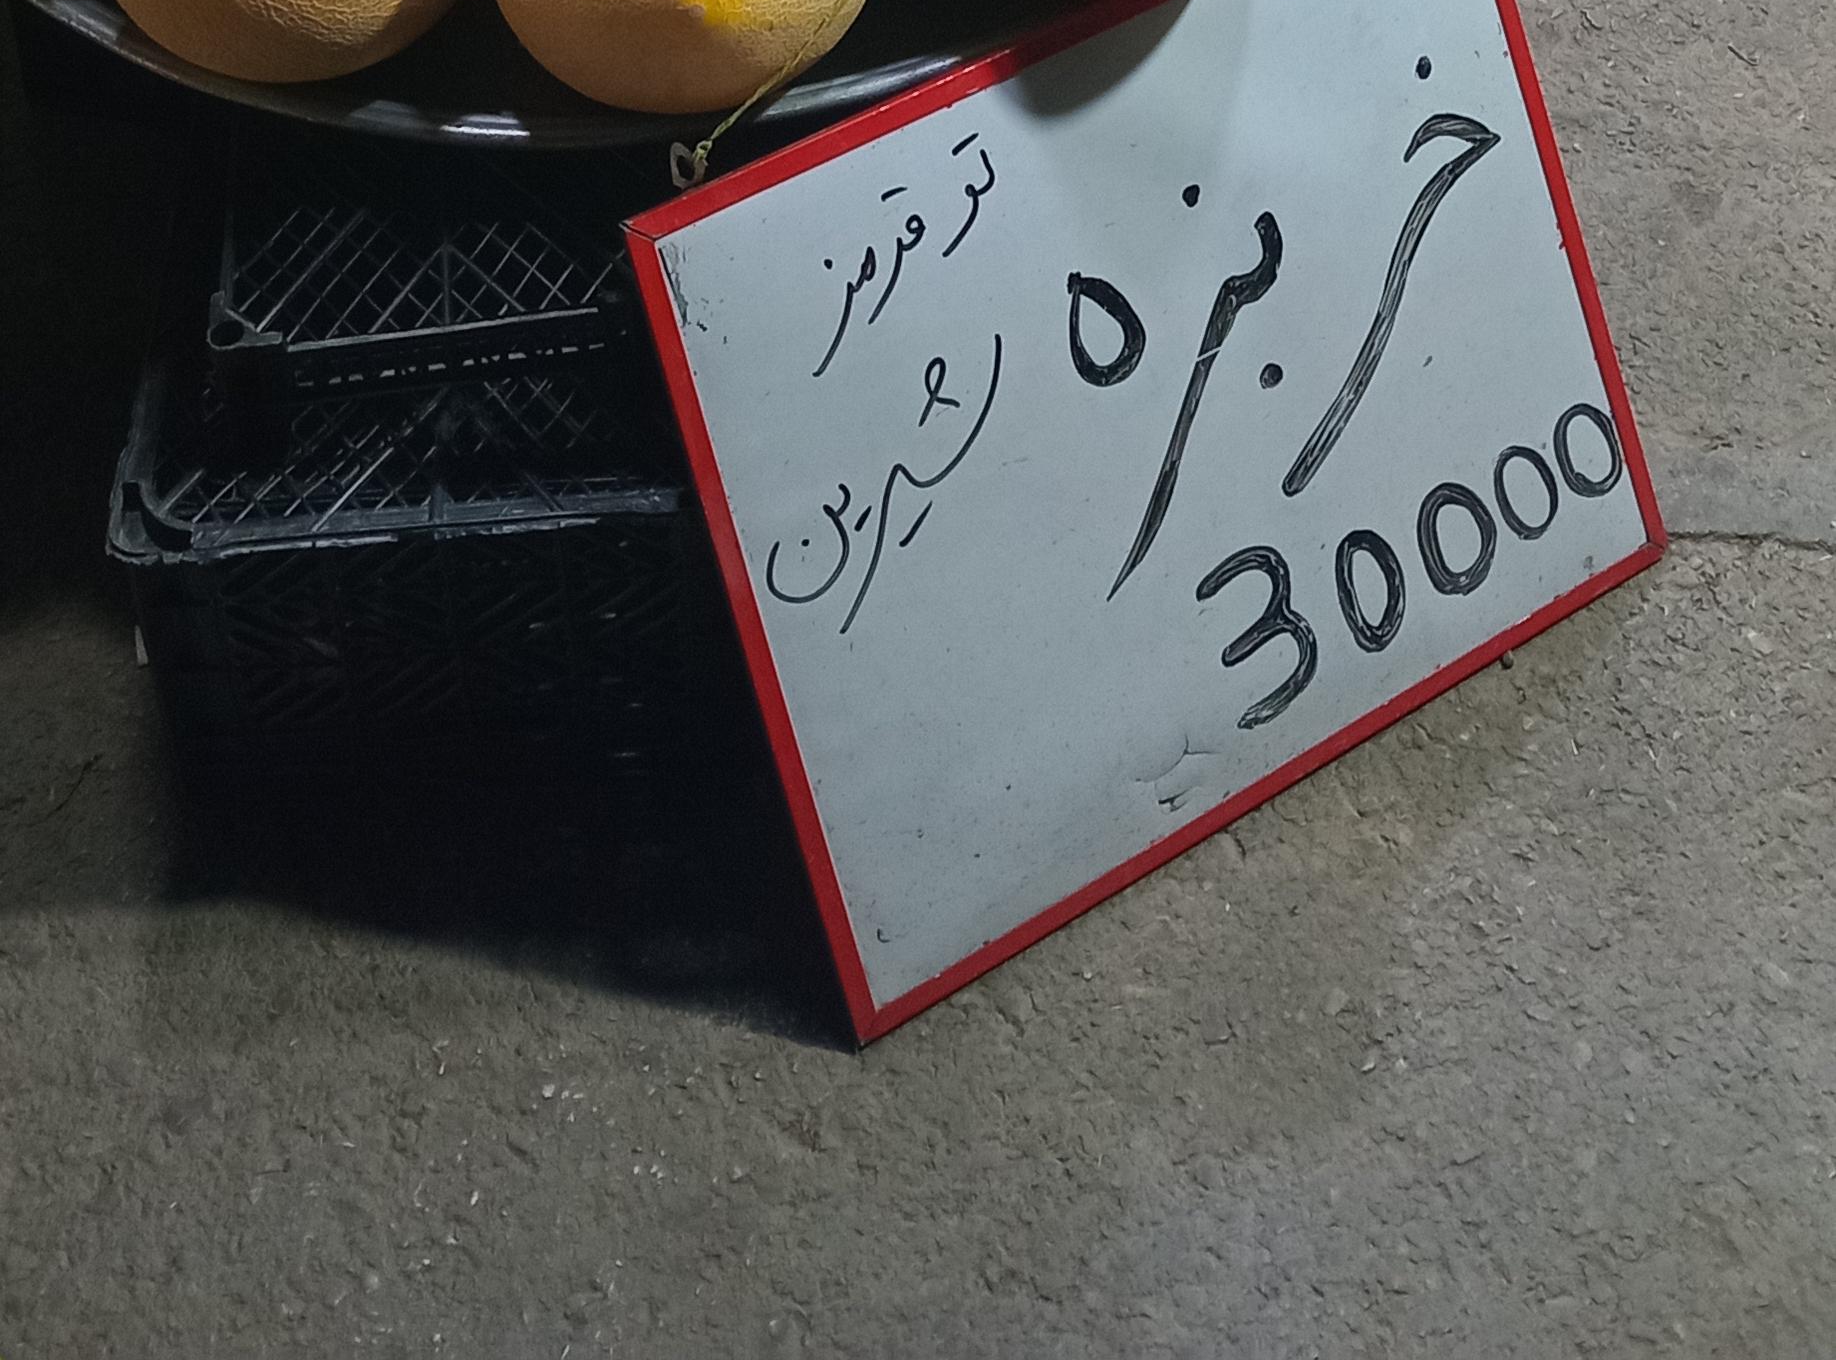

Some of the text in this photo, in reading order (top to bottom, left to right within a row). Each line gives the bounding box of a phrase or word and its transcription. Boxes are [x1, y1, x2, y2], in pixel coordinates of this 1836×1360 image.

[812, 132, 996, 378] تو قرمز
[1066, 56, 1502, 601] خربزه
[766, 333, 1002, 635] شیرین
[1196, 402, 1622, 730] 30000
